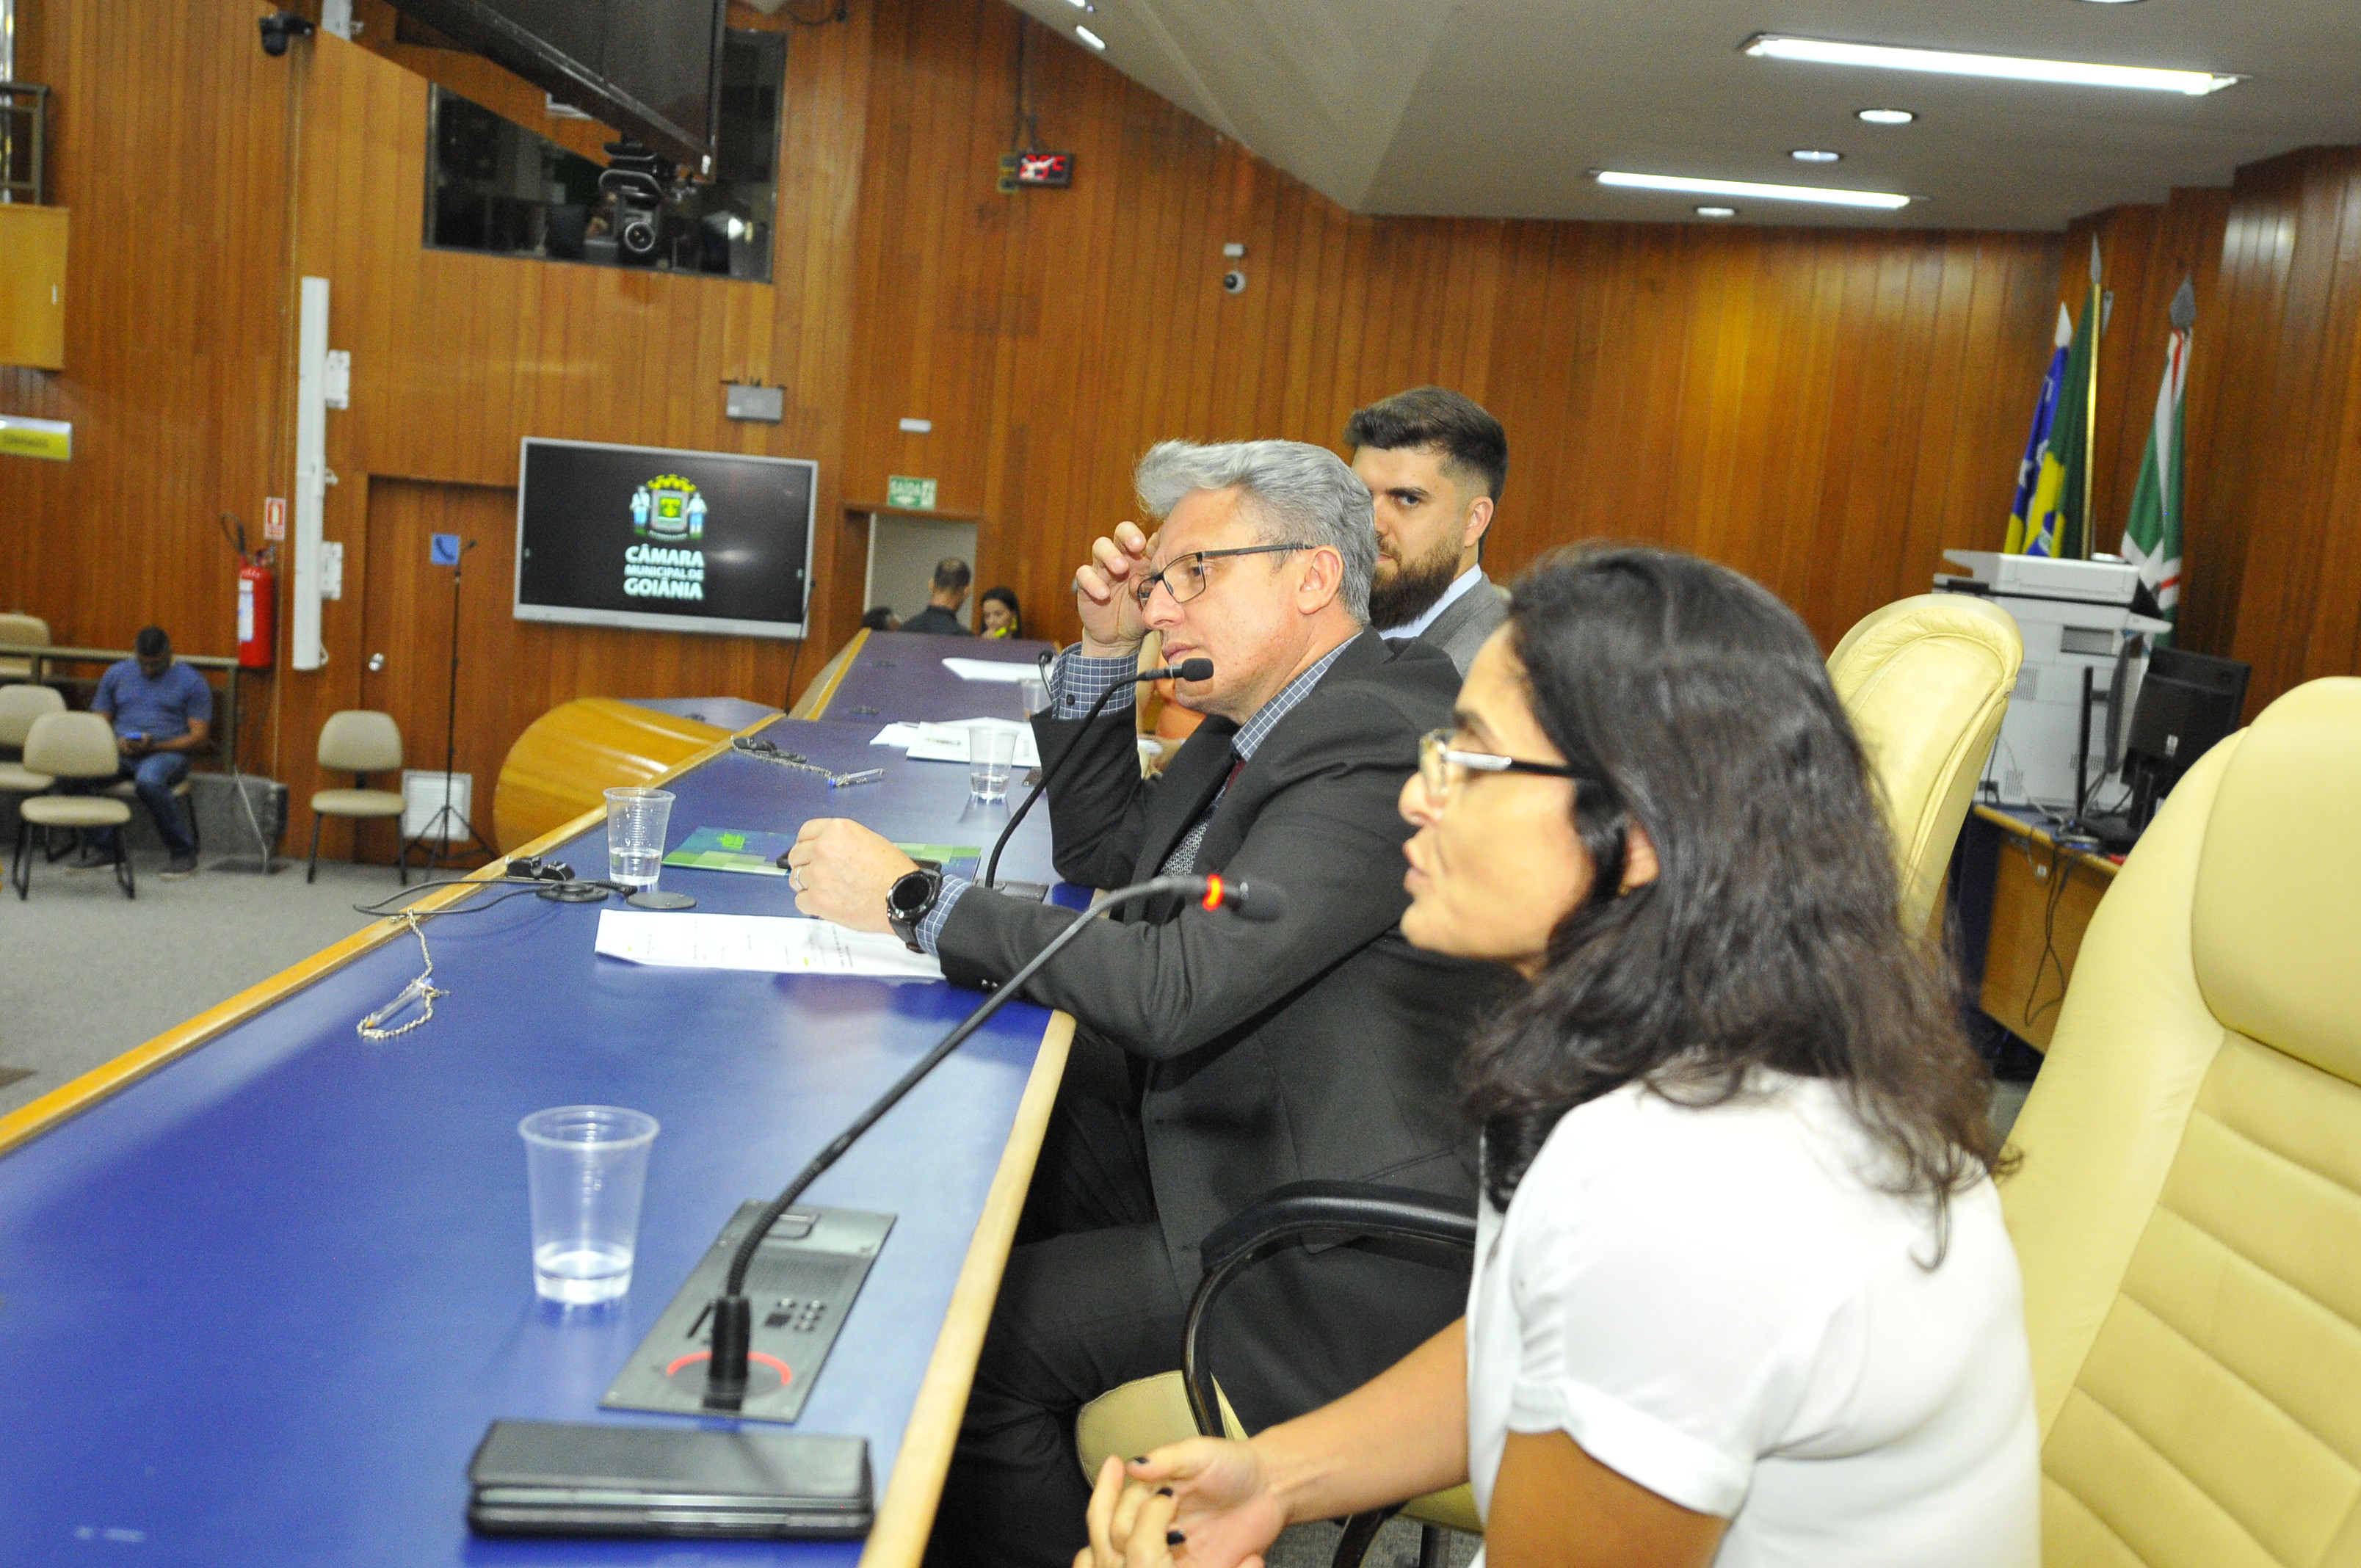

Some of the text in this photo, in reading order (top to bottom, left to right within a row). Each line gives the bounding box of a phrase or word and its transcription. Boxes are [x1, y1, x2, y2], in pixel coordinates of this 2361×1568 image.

[625, 543, 704, 568] CÂMARA
[624, 564, 704, 581] MUNICIPAL DE
[623, 577, 703, 600] GOIÂNIA
